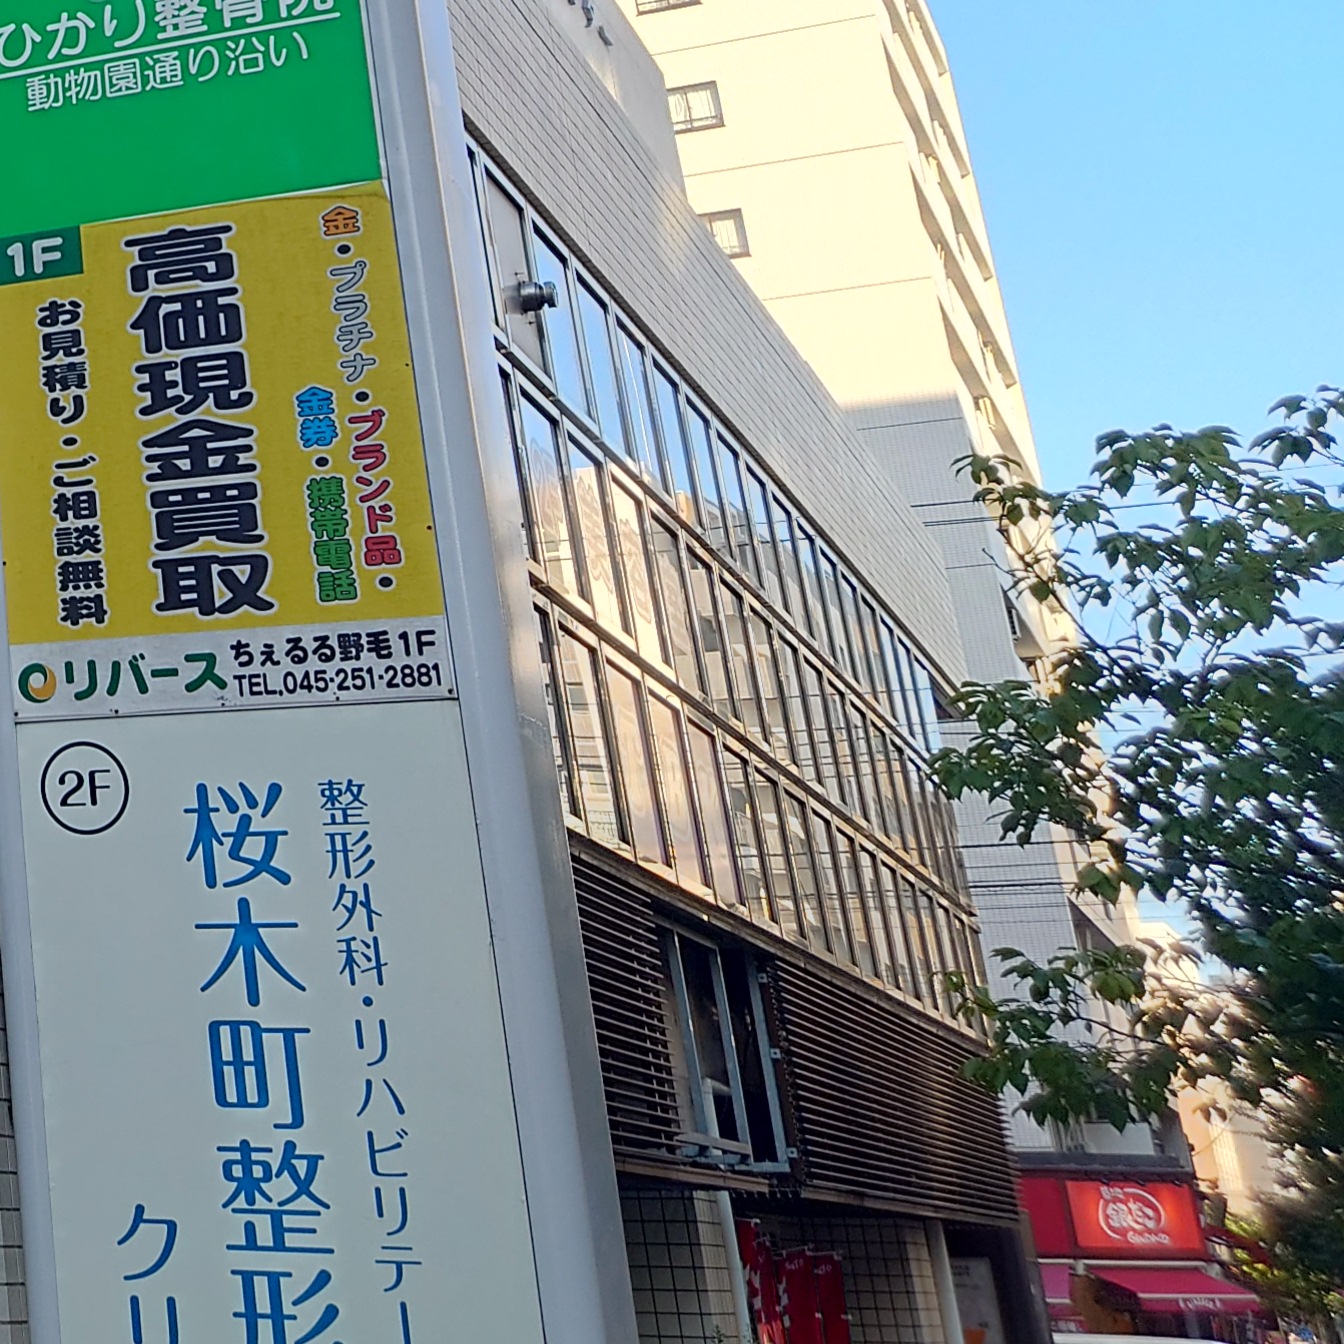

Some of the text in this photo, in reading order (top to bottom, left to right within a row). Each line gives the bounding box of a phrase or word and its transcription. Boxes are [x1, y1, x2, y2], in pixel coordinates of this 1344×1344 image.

[26, 31, 310, 112] 動物園通り沿い
[6, 237, 64, 278] 1F
[123, 223, 277, 617] 高価現金買取
[35, 298, 108, 627] お見積り・ご相談無料
[296, 385, 359, 603] 金券・携帯電話
[64, 652, 228, 702] リバース
[57, 768, 111, 808] 2F
